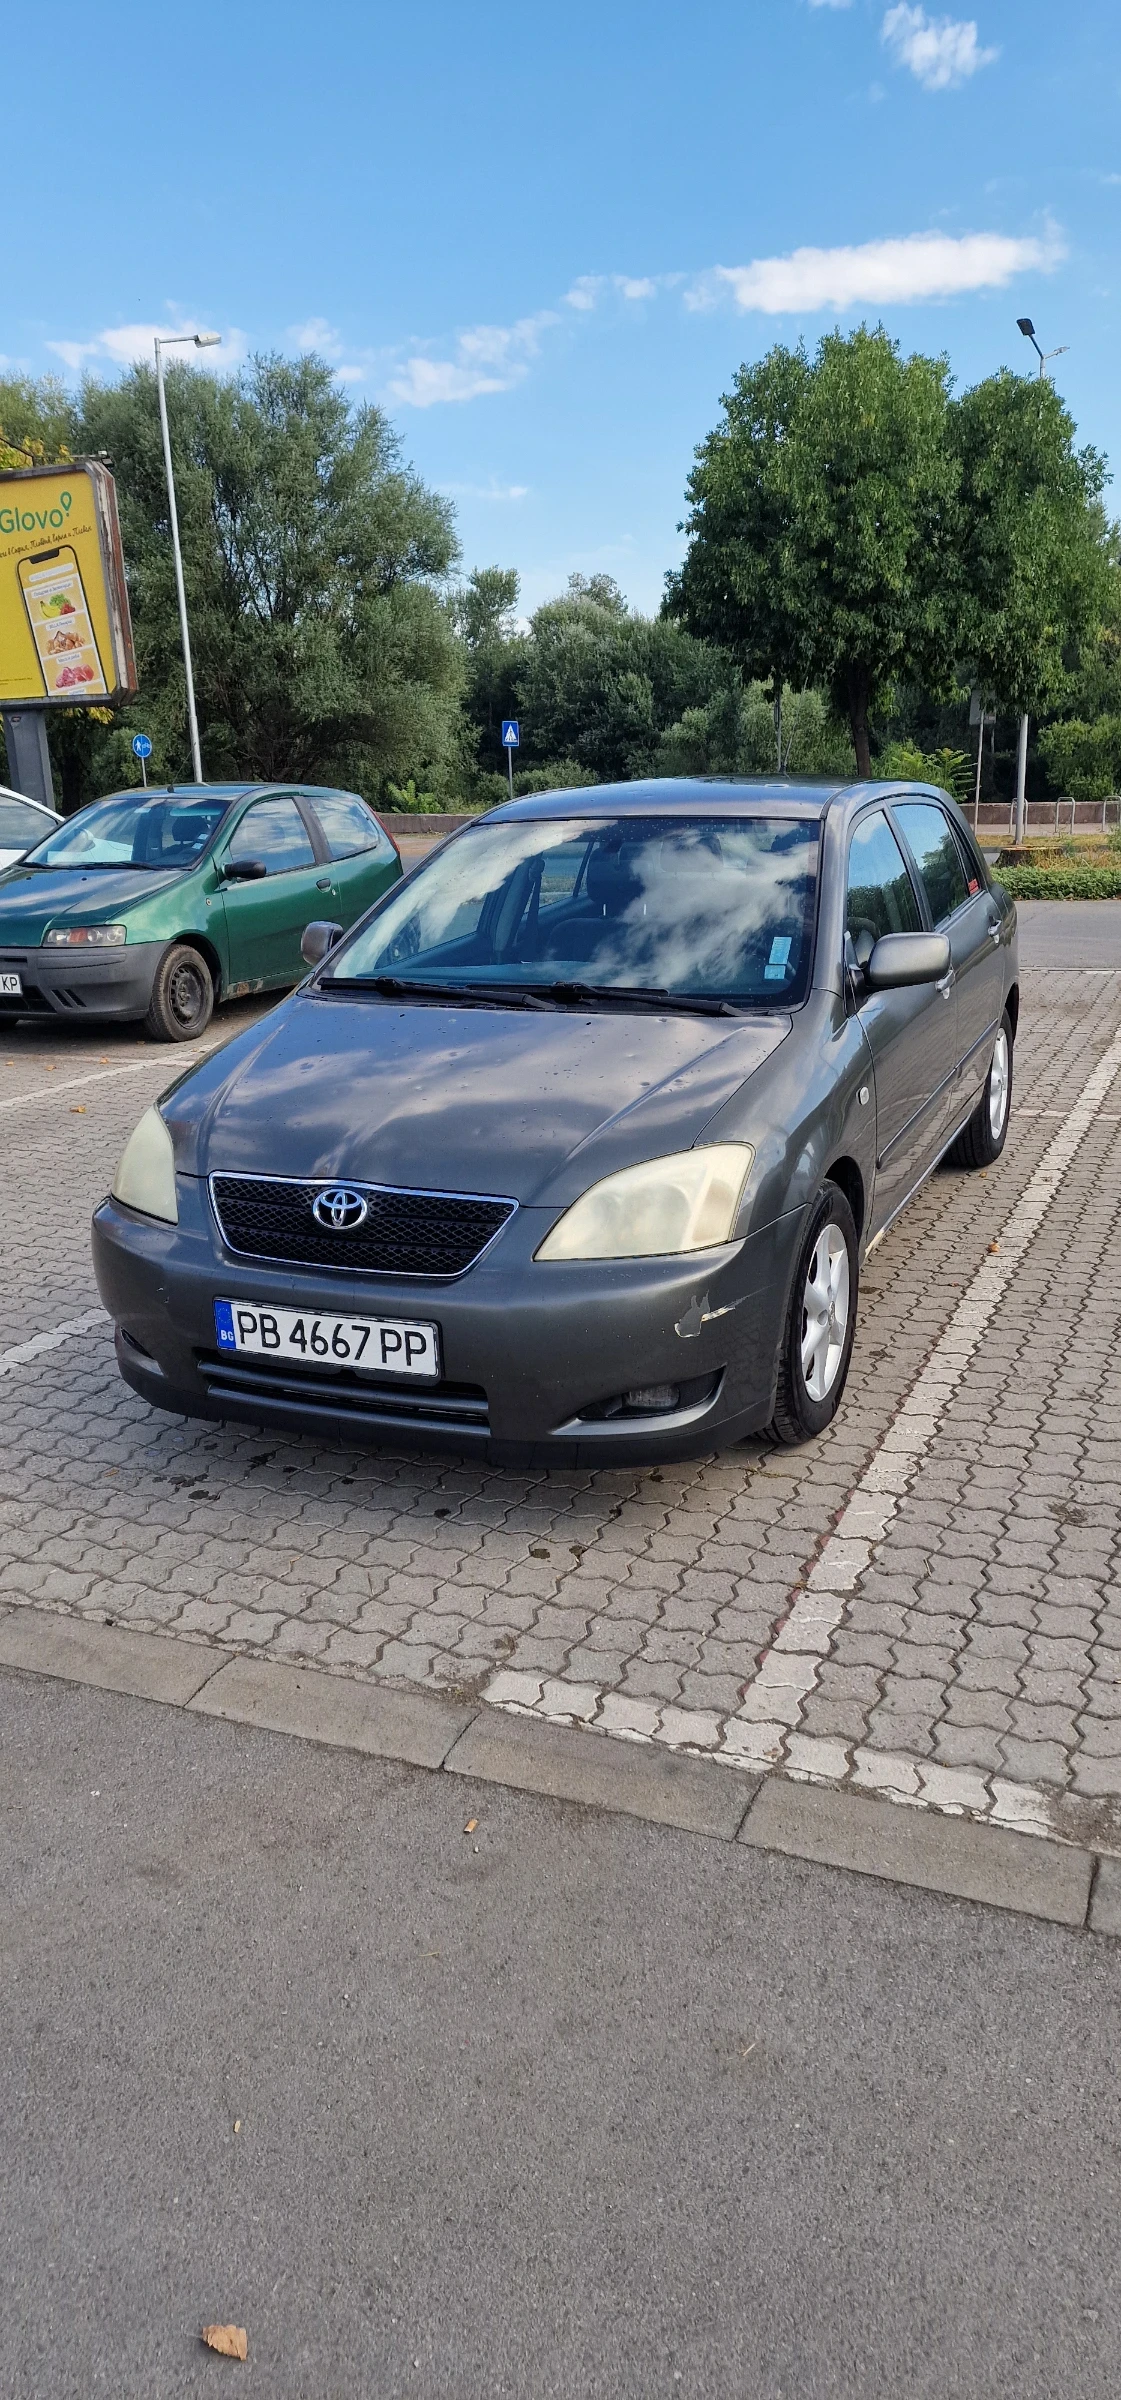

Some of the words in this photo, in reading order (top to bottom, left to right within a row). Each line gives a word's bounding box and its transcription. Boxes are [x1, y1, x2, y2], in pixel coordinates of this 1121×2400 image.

[0, 507, 63, 533] Glovo
[1, 975, 18, 991] KP
[220, 1330, 234, 1342] BG
[236, 1310, 281, 1349] PB
[289, 1318, 371, 1361] 4667
[380, 1328, 427, 1367] PP
